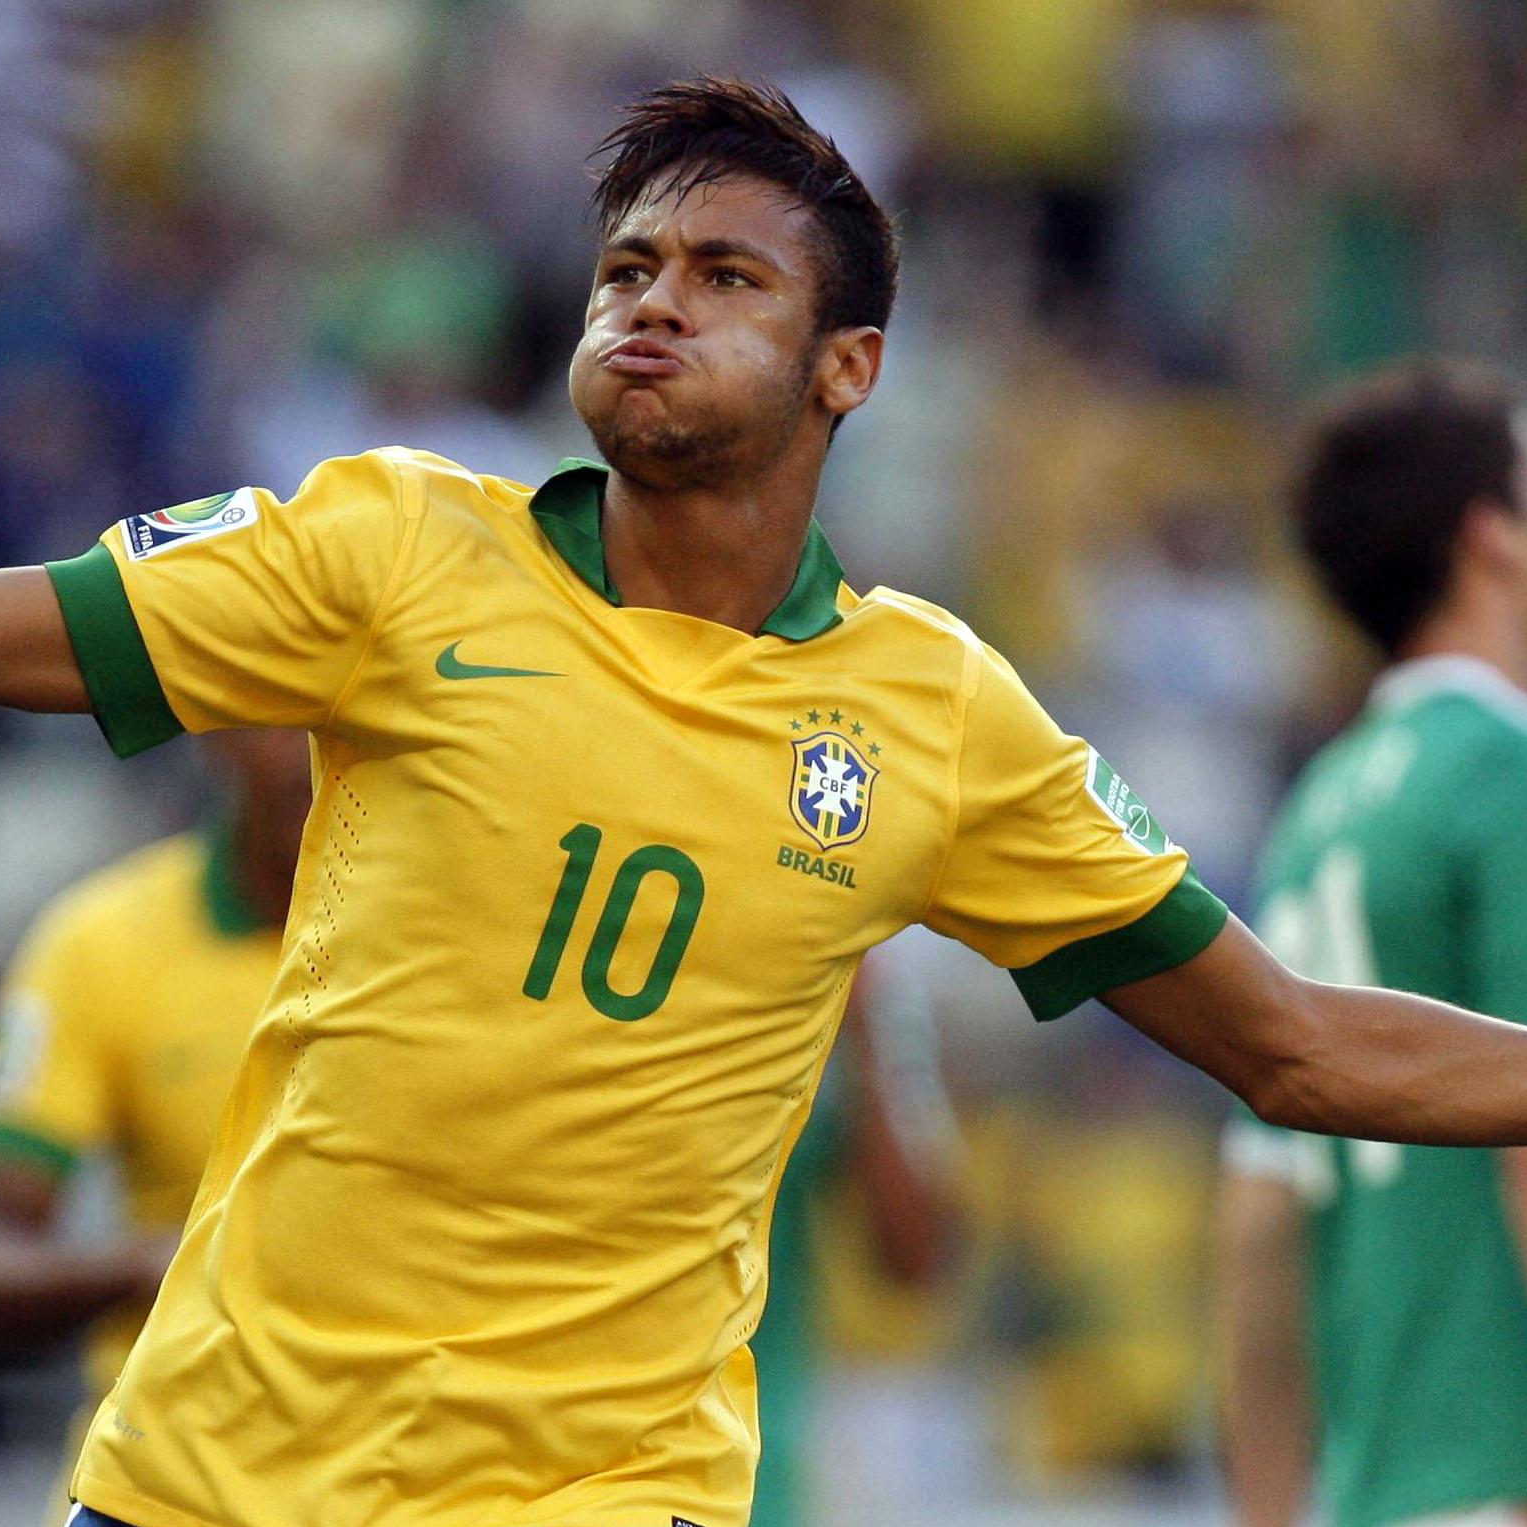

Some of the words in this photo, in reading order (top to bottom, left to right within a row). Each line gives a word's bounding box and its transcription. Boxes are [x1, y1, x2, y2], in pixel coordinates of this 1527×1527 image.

[137, 524, 154, 550] FIFA
[819, 776, 848, 795] CBF
[777, 845, 857, 889] BRASIL
[522, 822, 705, 1022] 10
